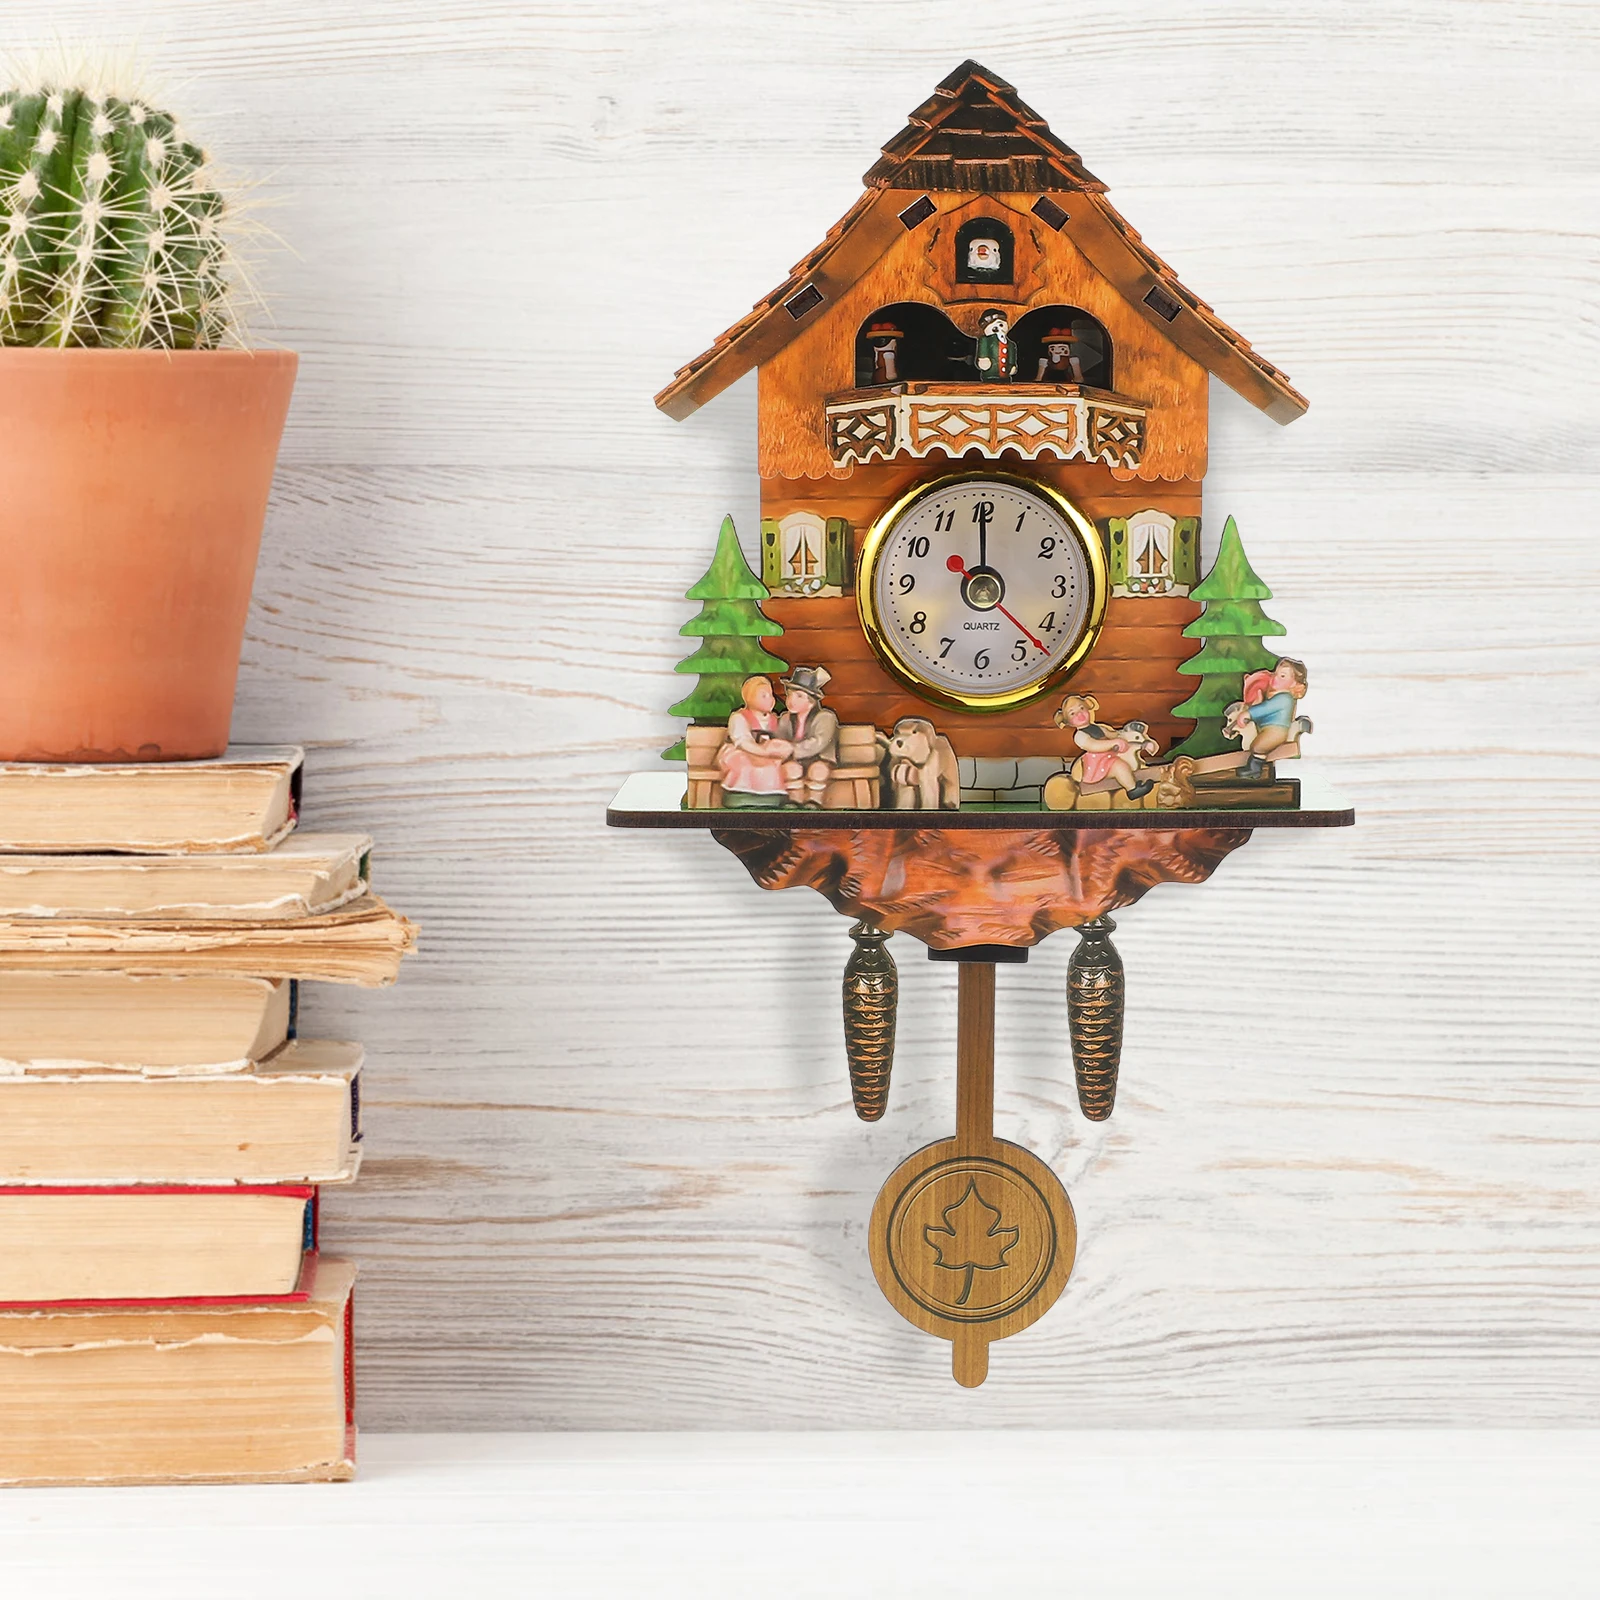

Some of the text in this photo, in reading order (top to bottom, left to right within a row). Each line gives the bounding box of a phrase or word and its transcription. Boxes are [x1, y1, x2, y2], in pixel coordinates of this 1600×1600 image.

[935, 510, 955, 532] 11
[972, 501, 995, 523] 12
[1015, 511, 1026, 532] 1
[907, 536, 930, 558] 10
[1037, 536, 1056, 560] 2
[898, 574, 916, 596] 9
[1051, 574, 1067, 599] 3
[909, 611, 927, 635] 8
[962, 621, 1000, 631] QUARTZ
[1037, 611, 1056, 632] 4
[939, 637, 956, 659] 7
[973, 647, 991, 670] 6
[1010, 639, 1028, 662] 5
